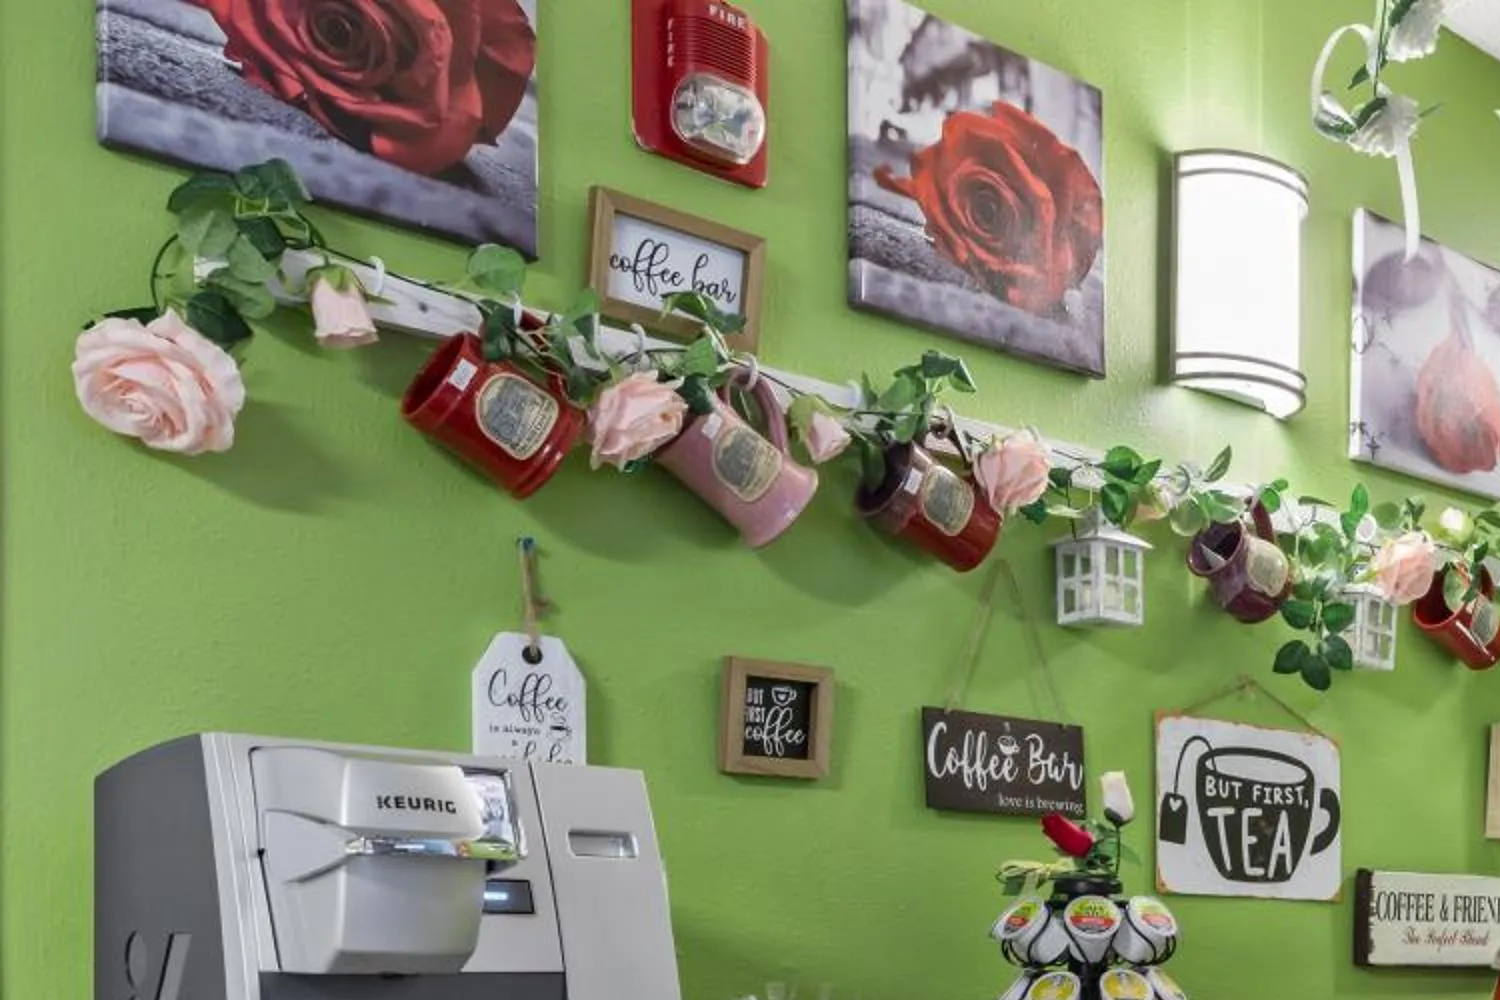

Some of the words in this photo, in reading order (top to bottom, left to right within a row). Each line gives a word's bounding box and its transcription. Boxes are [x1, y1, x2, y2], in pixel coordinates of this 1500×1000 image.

[708, 4, 746, 29] FIRE
[609, 238, 684, 296] coffee
[692, 253, 737, 303] bar
[488, 668, 568, 723] Coffee
[745, 705, 805, 757] coffee
[927, 721, 1018, 792] Coffee
[1025, 733, 1083, 791] Bar
[377, 796, 457, 815] KEURIG
[1025, 796, 1035, 809] is
[1205, 775, 1243, 800] BUT
[1253, 784, 1309, 808] FIRST,
[1207, 807, 1293, 880] TEA
[1376, 891, 1435, 921] COFFEE
[1440, 893, 1449, 921] &
